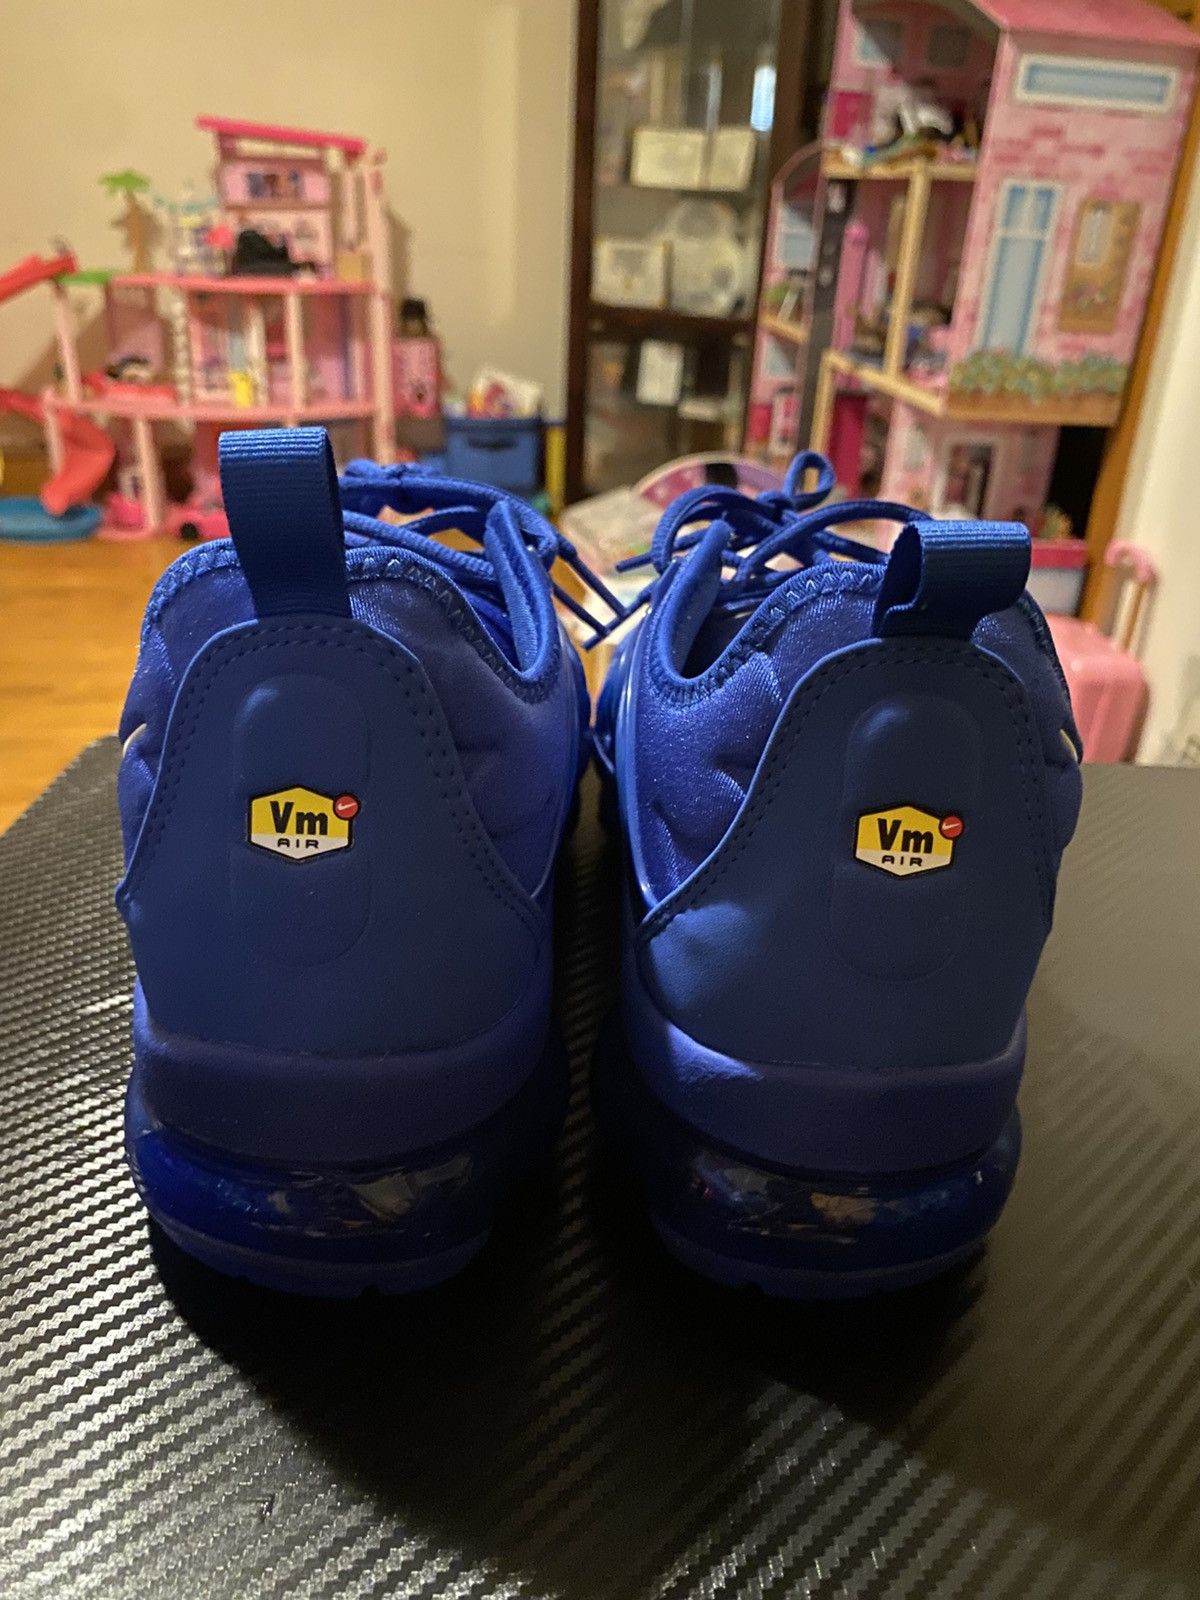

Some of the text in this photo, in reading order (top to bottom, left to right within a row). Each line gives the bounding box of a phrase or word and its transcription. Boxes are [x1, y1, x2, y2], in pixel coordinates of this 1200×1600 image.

[269, 800, 328, 836] Vm
[277, 837, 319, 849] AIR
[877, 818, 934, 854] Vm
[881, 855, 923, 867] AIR
